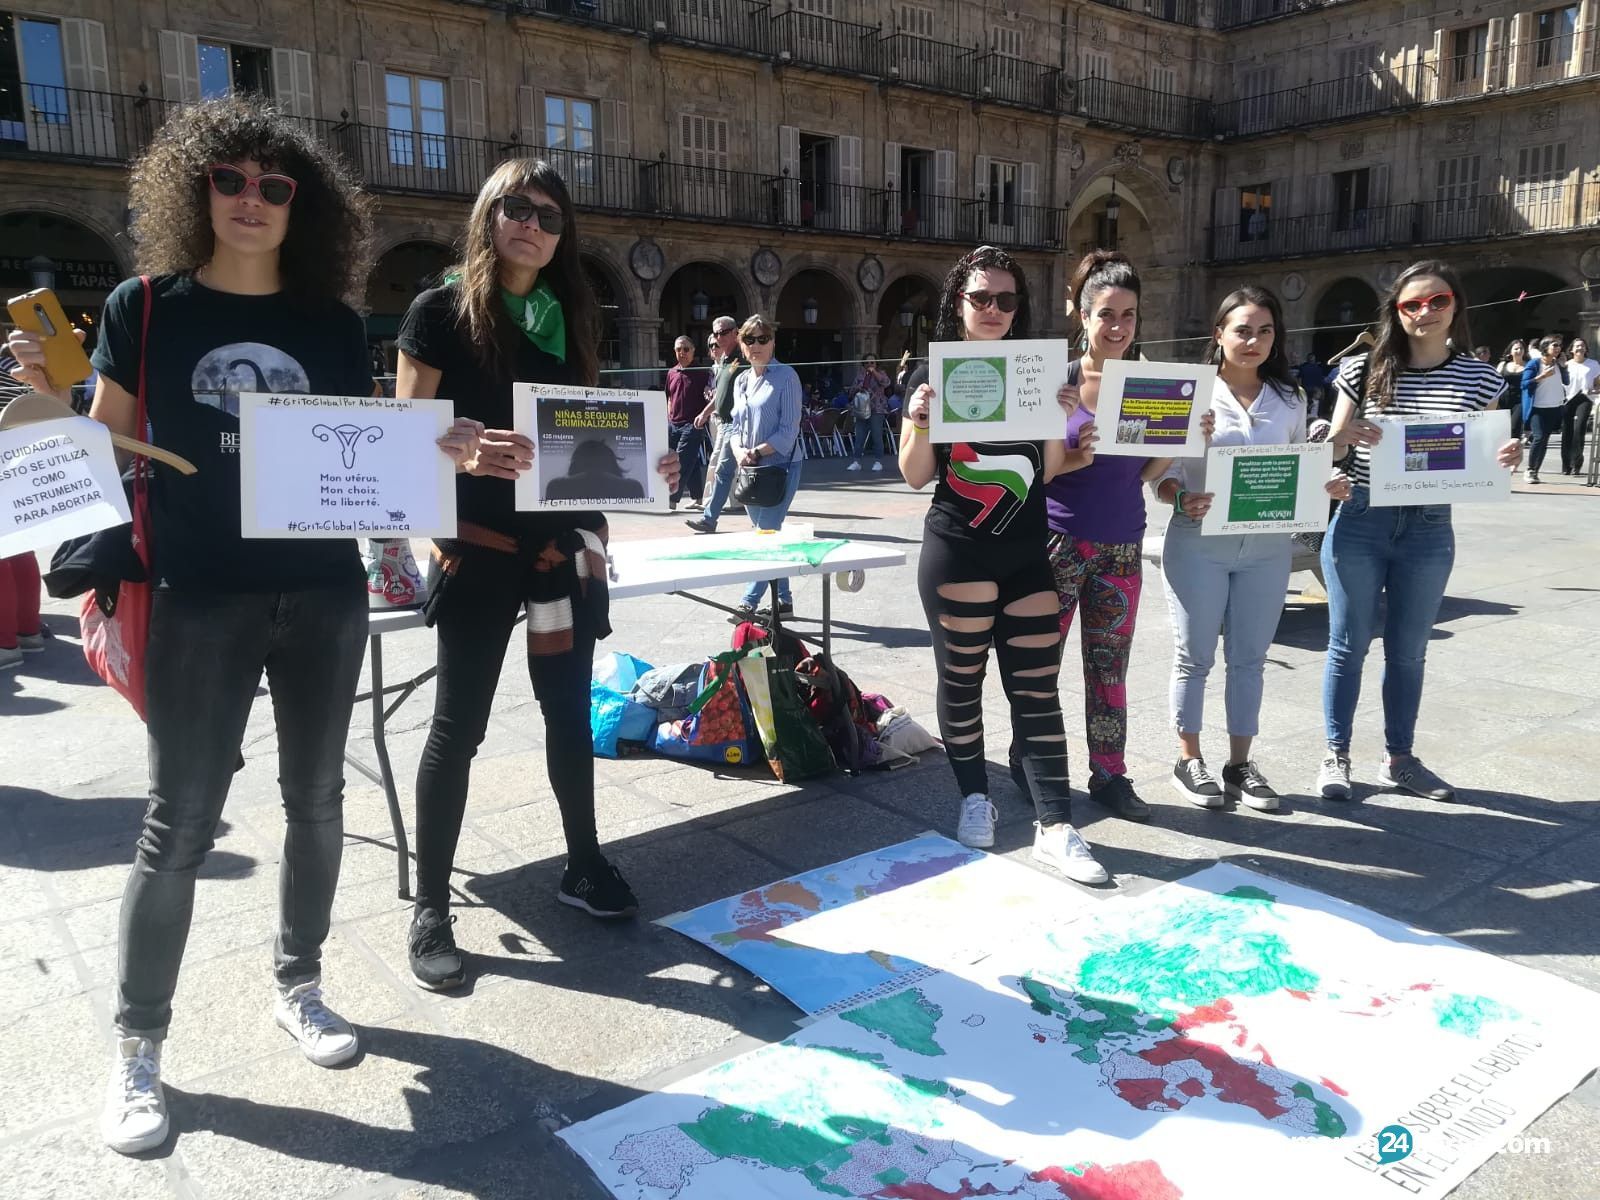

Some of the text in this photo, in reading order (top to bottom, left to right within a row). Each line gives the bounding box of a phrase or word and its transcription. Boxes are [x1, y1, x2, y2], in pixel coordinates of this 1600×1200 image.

[70, 275, 117, 287] TAPAS
[1016, 366, 1045, 375] Global
[385, 401, 413, 411] Legal
[555, 409, 629, 420] NIÑAS SEGUIRÁN
[555, 419, 629, 429] CRIMINALIZADAS
[29, 459, 46, 472] SE
[48, 448, 89, 467] UTILIZA
[32, 470, 66, 487] COMO
[320, 474, 379, 483] Mon utérus.
[13, 478, 92, 509] INSTRUMENTO
[321, 485, 380, 495] Mon choix.
[14, 490, 102, 525] PARA ABORTAR
[321, 497, 380, 507] Ma liberté.
[1381, 1162, 1436, 1194] EN
